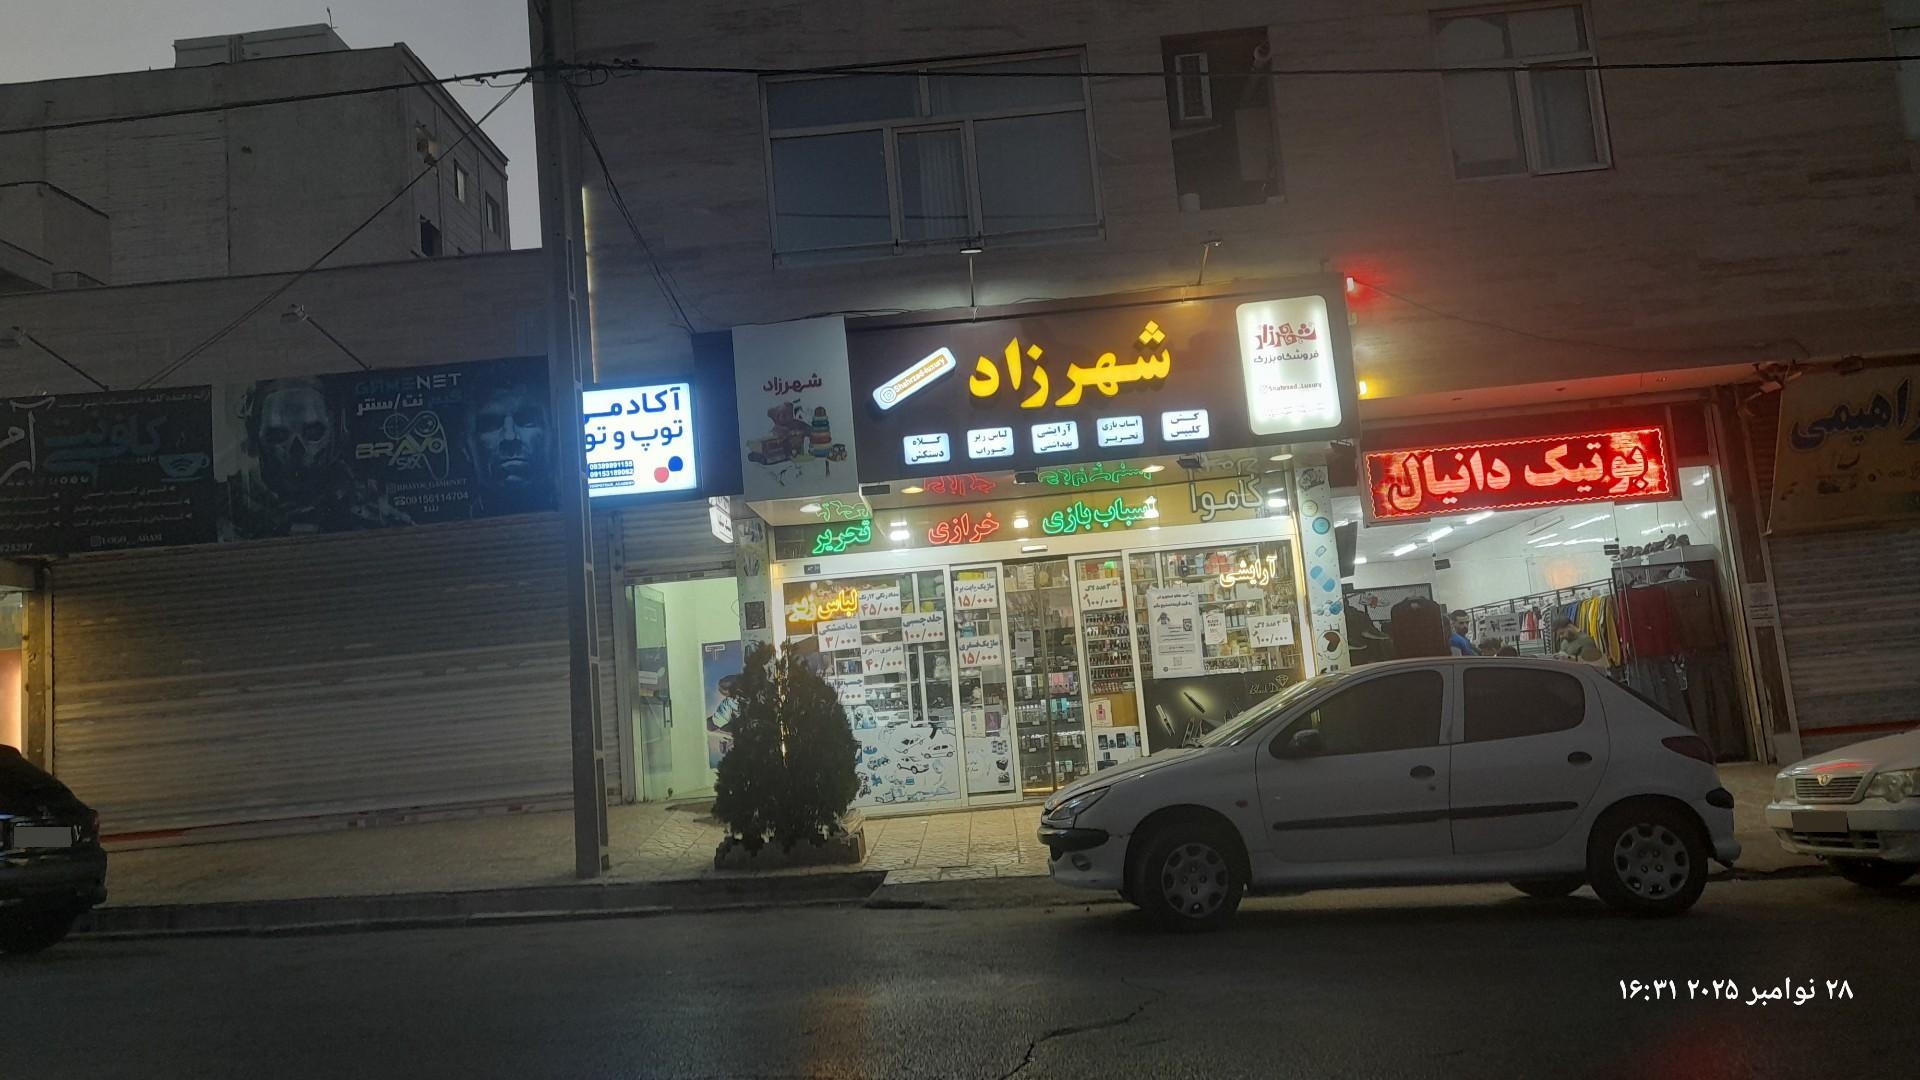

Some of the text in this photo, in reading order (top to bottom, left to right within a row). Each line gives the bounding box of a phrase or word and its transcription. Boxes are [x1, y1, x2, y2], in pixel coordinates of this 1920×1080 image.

[1277, 349, 1319, 361] فروشگاه
[969, 320, 1171, 409] شهرزاد
[763, 373, 822, 395] شهرزاد
[1171, 412, 1199, 424] کش
[1791, 377, 1920, 452] اهیمی
[585, 419, 683, 452] توپ و تو
[974, 430, 1007, 442] لباس زیر
[1037, 423, 1071, 438] آرایشی
[1171, 425, 1201, 437] کلیپس
[913, 436, 941, 446] کلاه
[1040, 440, 1072, 451] بهداشتی
[1104, 434, 1139, 444] تحریر
[355, 434, 447, 465] BRAVO
[911, 450, 944, 462] دستکش
[976, 446, 1006, 455] جوراب
[397, 456, 422, 470] SIX
[1387, 442, 1645, 511] بوتیک دانیال
[1190, 474, 1262, 521] کاموا
[1042, 501, 1092, 534] بازی
[928, 513, 1000, 545] خرازی
[812, 519, 872, 554] تحریر
[1219, 554, 1277, 588] آرایشی
[977, 583, 995, 592] ماژیک
[818, 588, 858, 620] لباس
[958, 594, 994, 607] ۱۵/۰۰۰
[1087, 596, 1118, 607] ۱۰۰/۰۰۰
[862, 602, 900, 616] ۴۵/۰۰۰
[825, 635, 856, 649] ۳/۰۰۰
[904, 628, 944, 642] ۱۰۰/۰۰۰
[1257, 633, 1288, 644] ۱۰۰/۰۰۰
[865, 657, 902, 671] ۴۰/۰۰۰
[962, 650, 998, 664] ۱۵/۰۰۰
